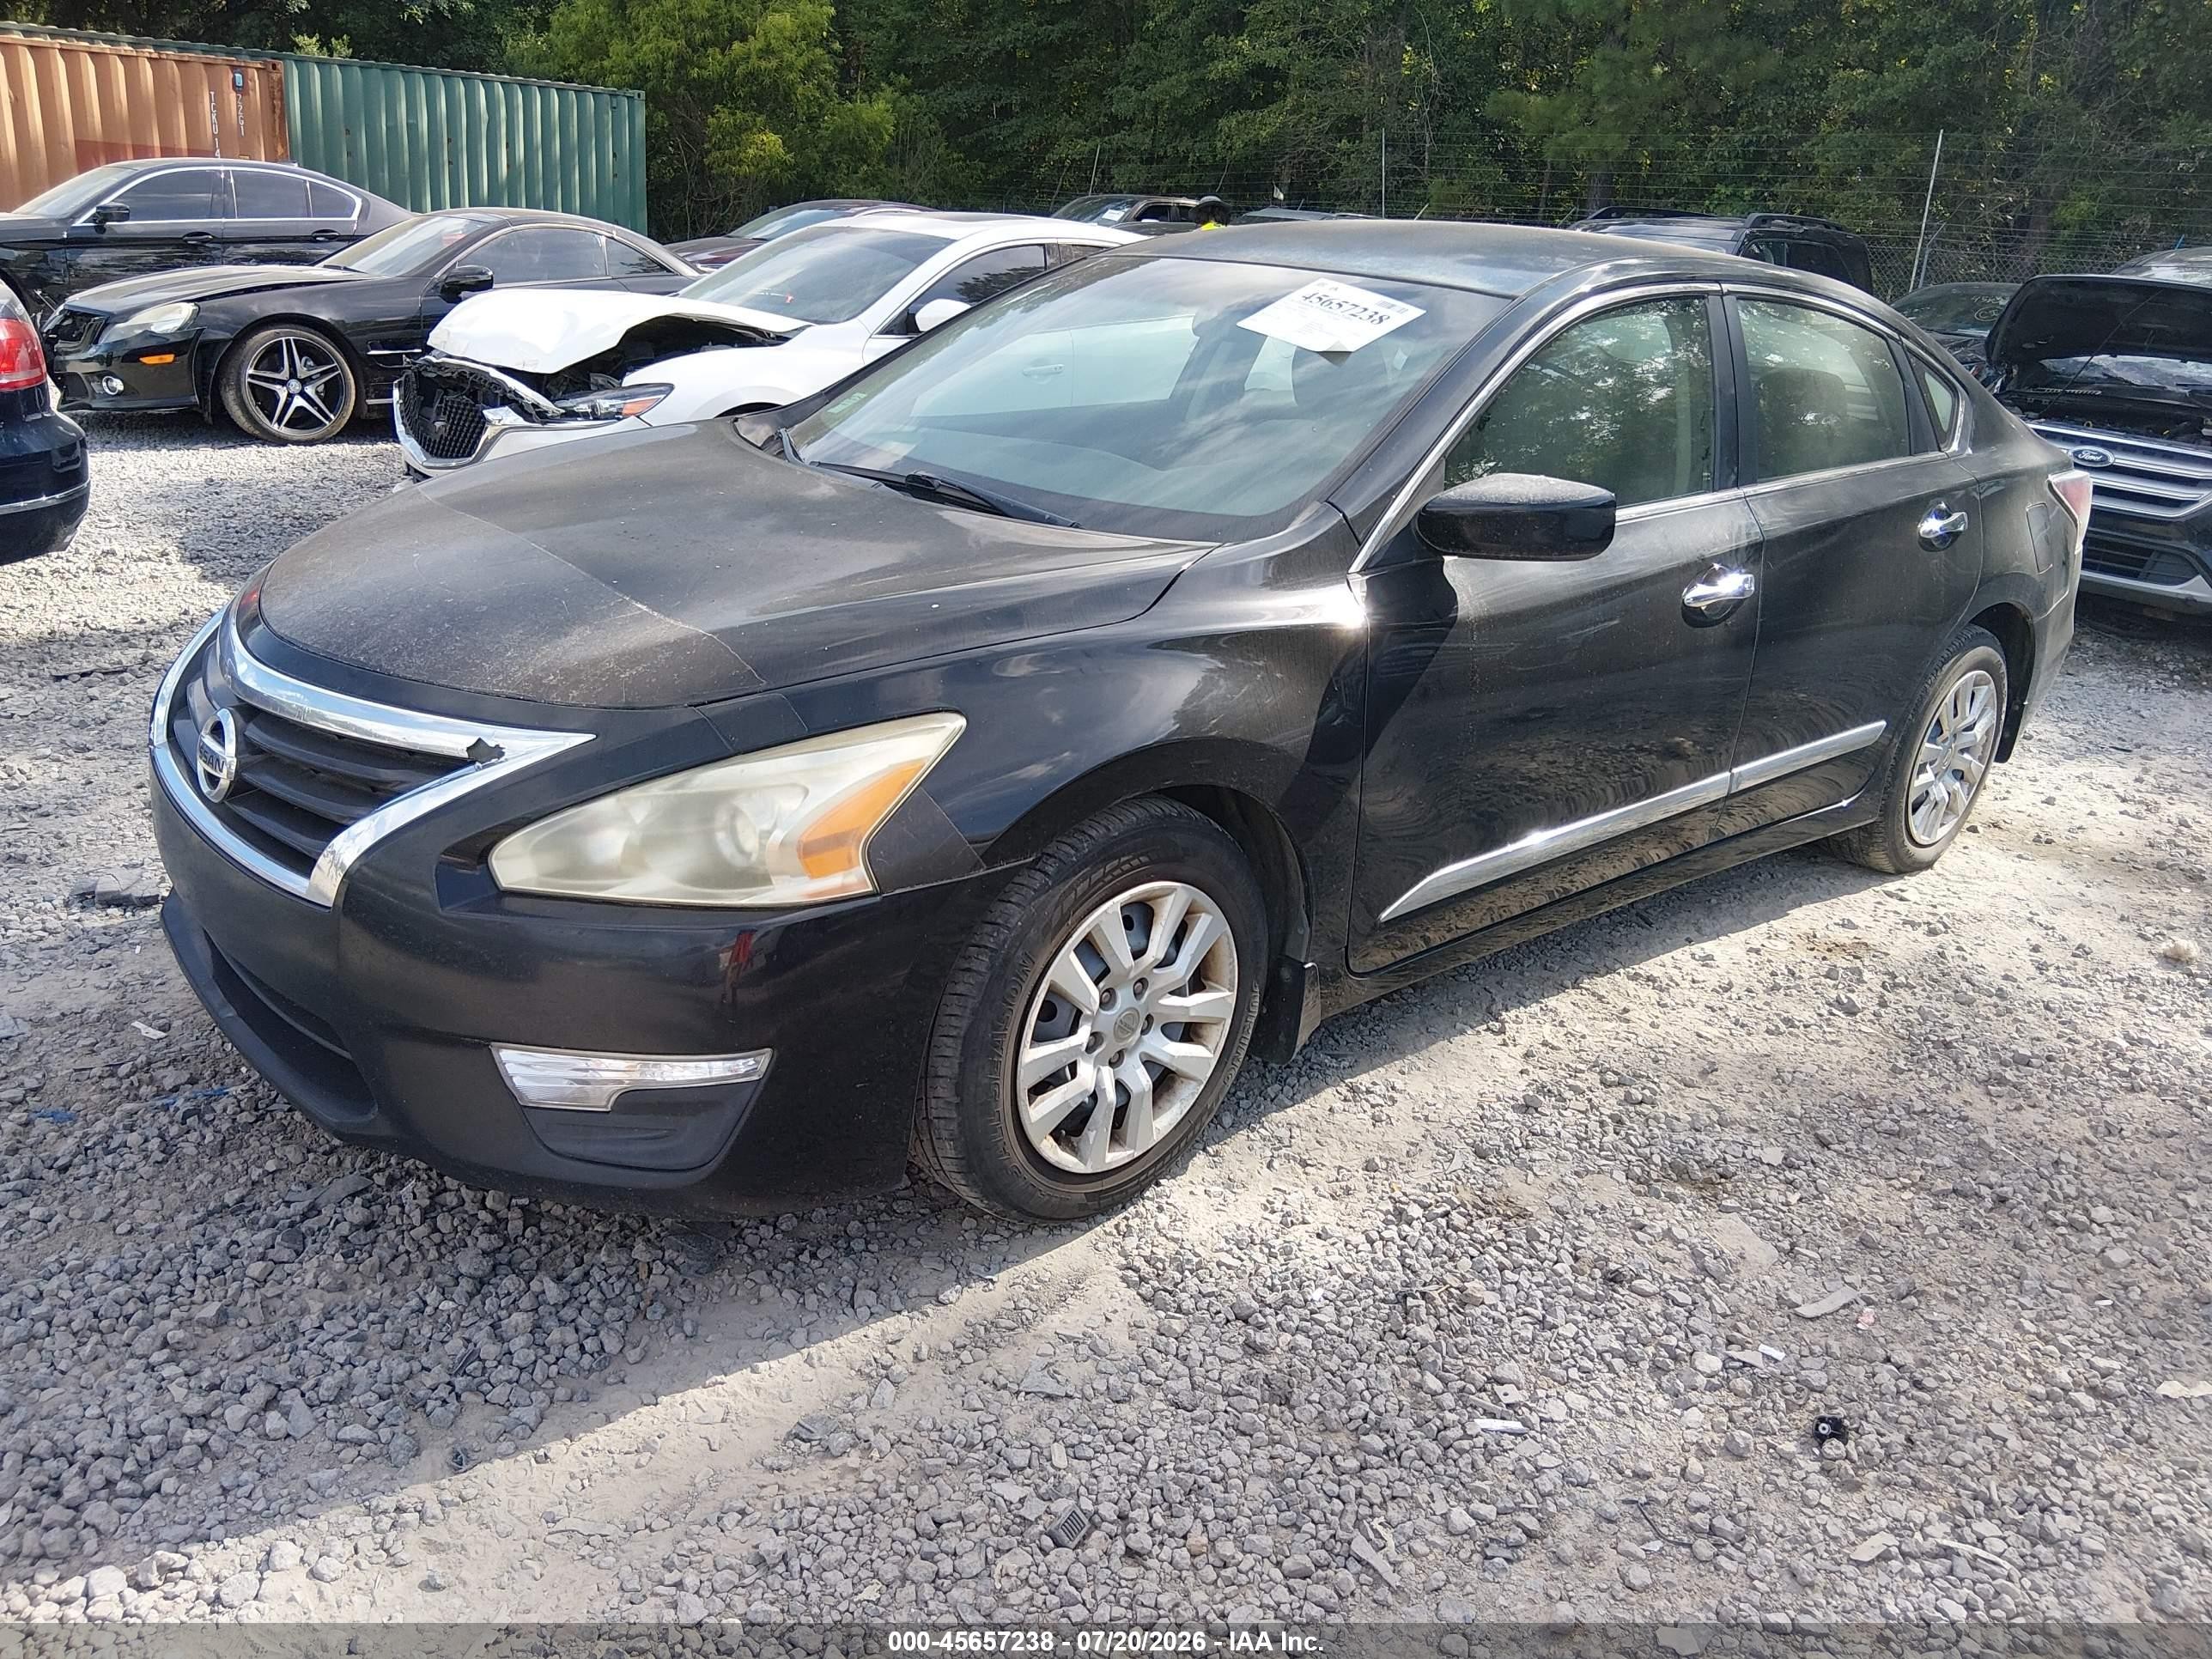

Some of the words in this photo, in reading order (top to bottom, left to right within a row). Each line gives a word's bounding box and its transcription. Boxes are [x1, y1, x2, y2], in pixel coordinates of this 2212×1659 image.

[210, 91, 218, 134] TCKU
[1301, 292, 1391, 325] 45657238
[2077, 449, 2103, 462] Ford
[198, 740, 226, 773] SSAN
